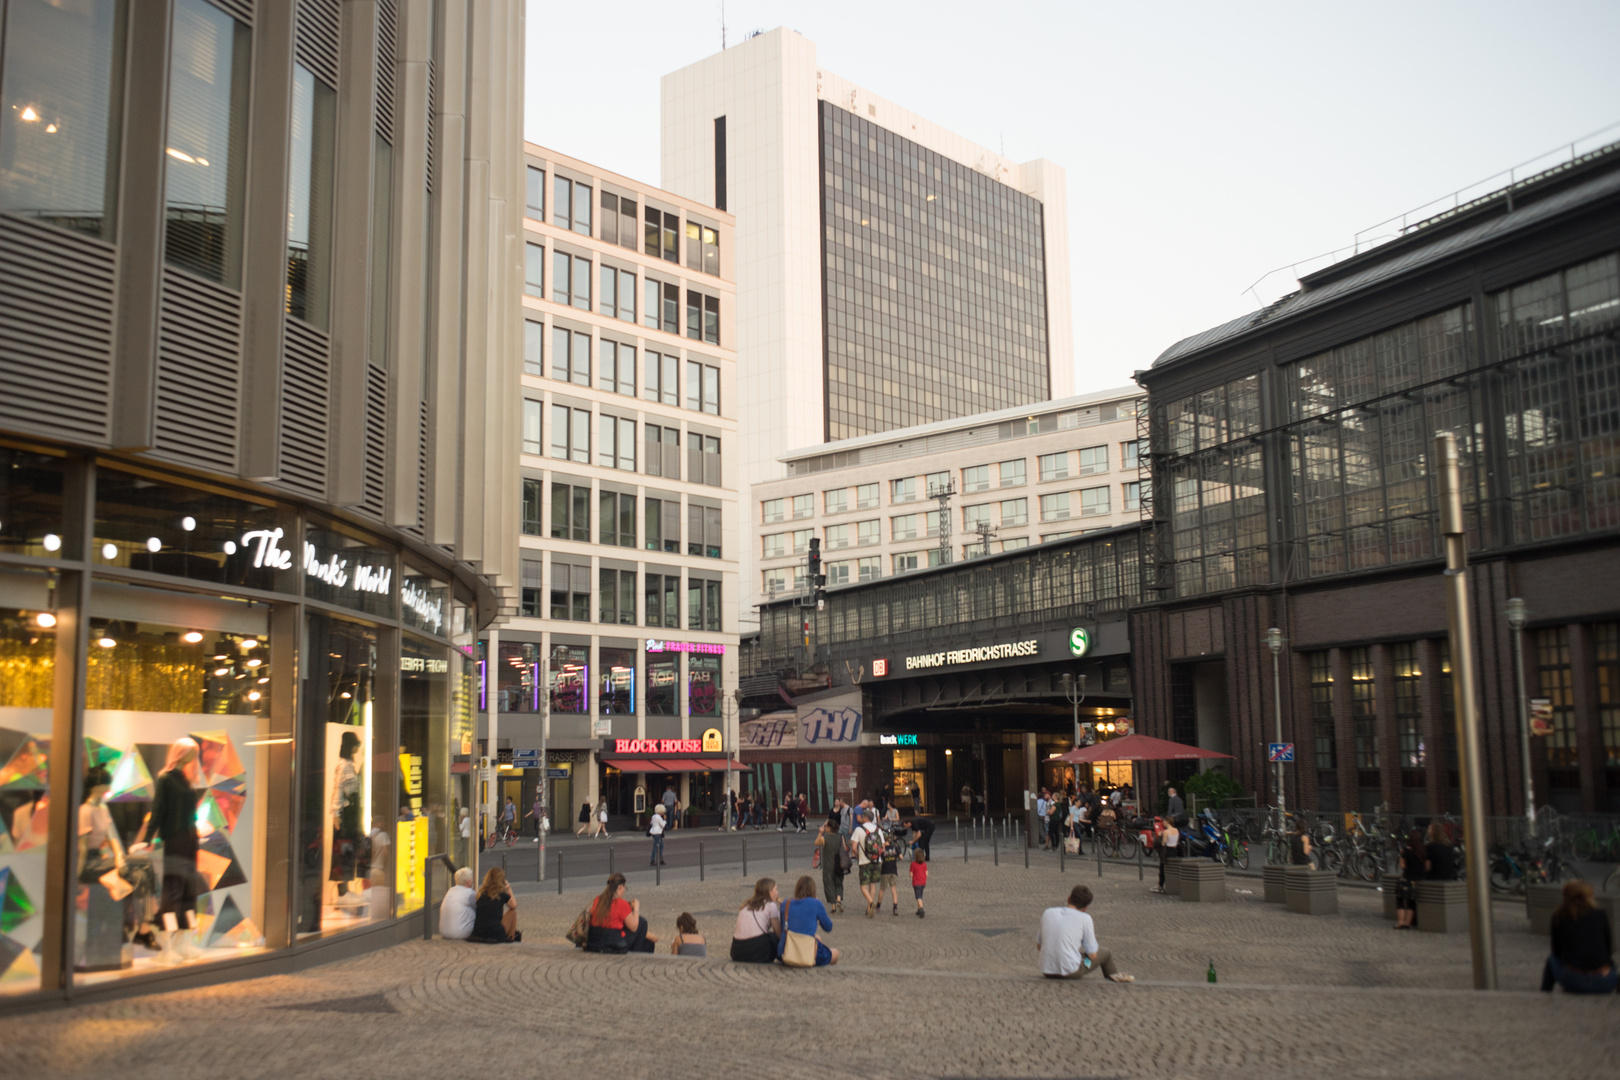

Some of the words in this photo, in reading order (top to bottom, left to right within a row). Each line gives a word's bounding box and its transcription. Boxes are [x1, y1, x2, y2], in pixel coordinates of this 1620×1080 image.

[241, 527, 292, 570] The
[354, 564, 392, 595] World
[646, 639, 664, 652] Pink
[666, 641, 695, 653] FRAUEN
[696, 643, 726, 654] FITNESS
[1070, 629, 1087, 656] S
[906, 652, 946, 670] BAHNHOF
[946, 640, 1038, 665] FRIEDRICHSTRASSE
[873, 660, 885, 675] DB
[615, 739, 659, 753] BLOCK
[660, 739, 702, 753] HOUSE
